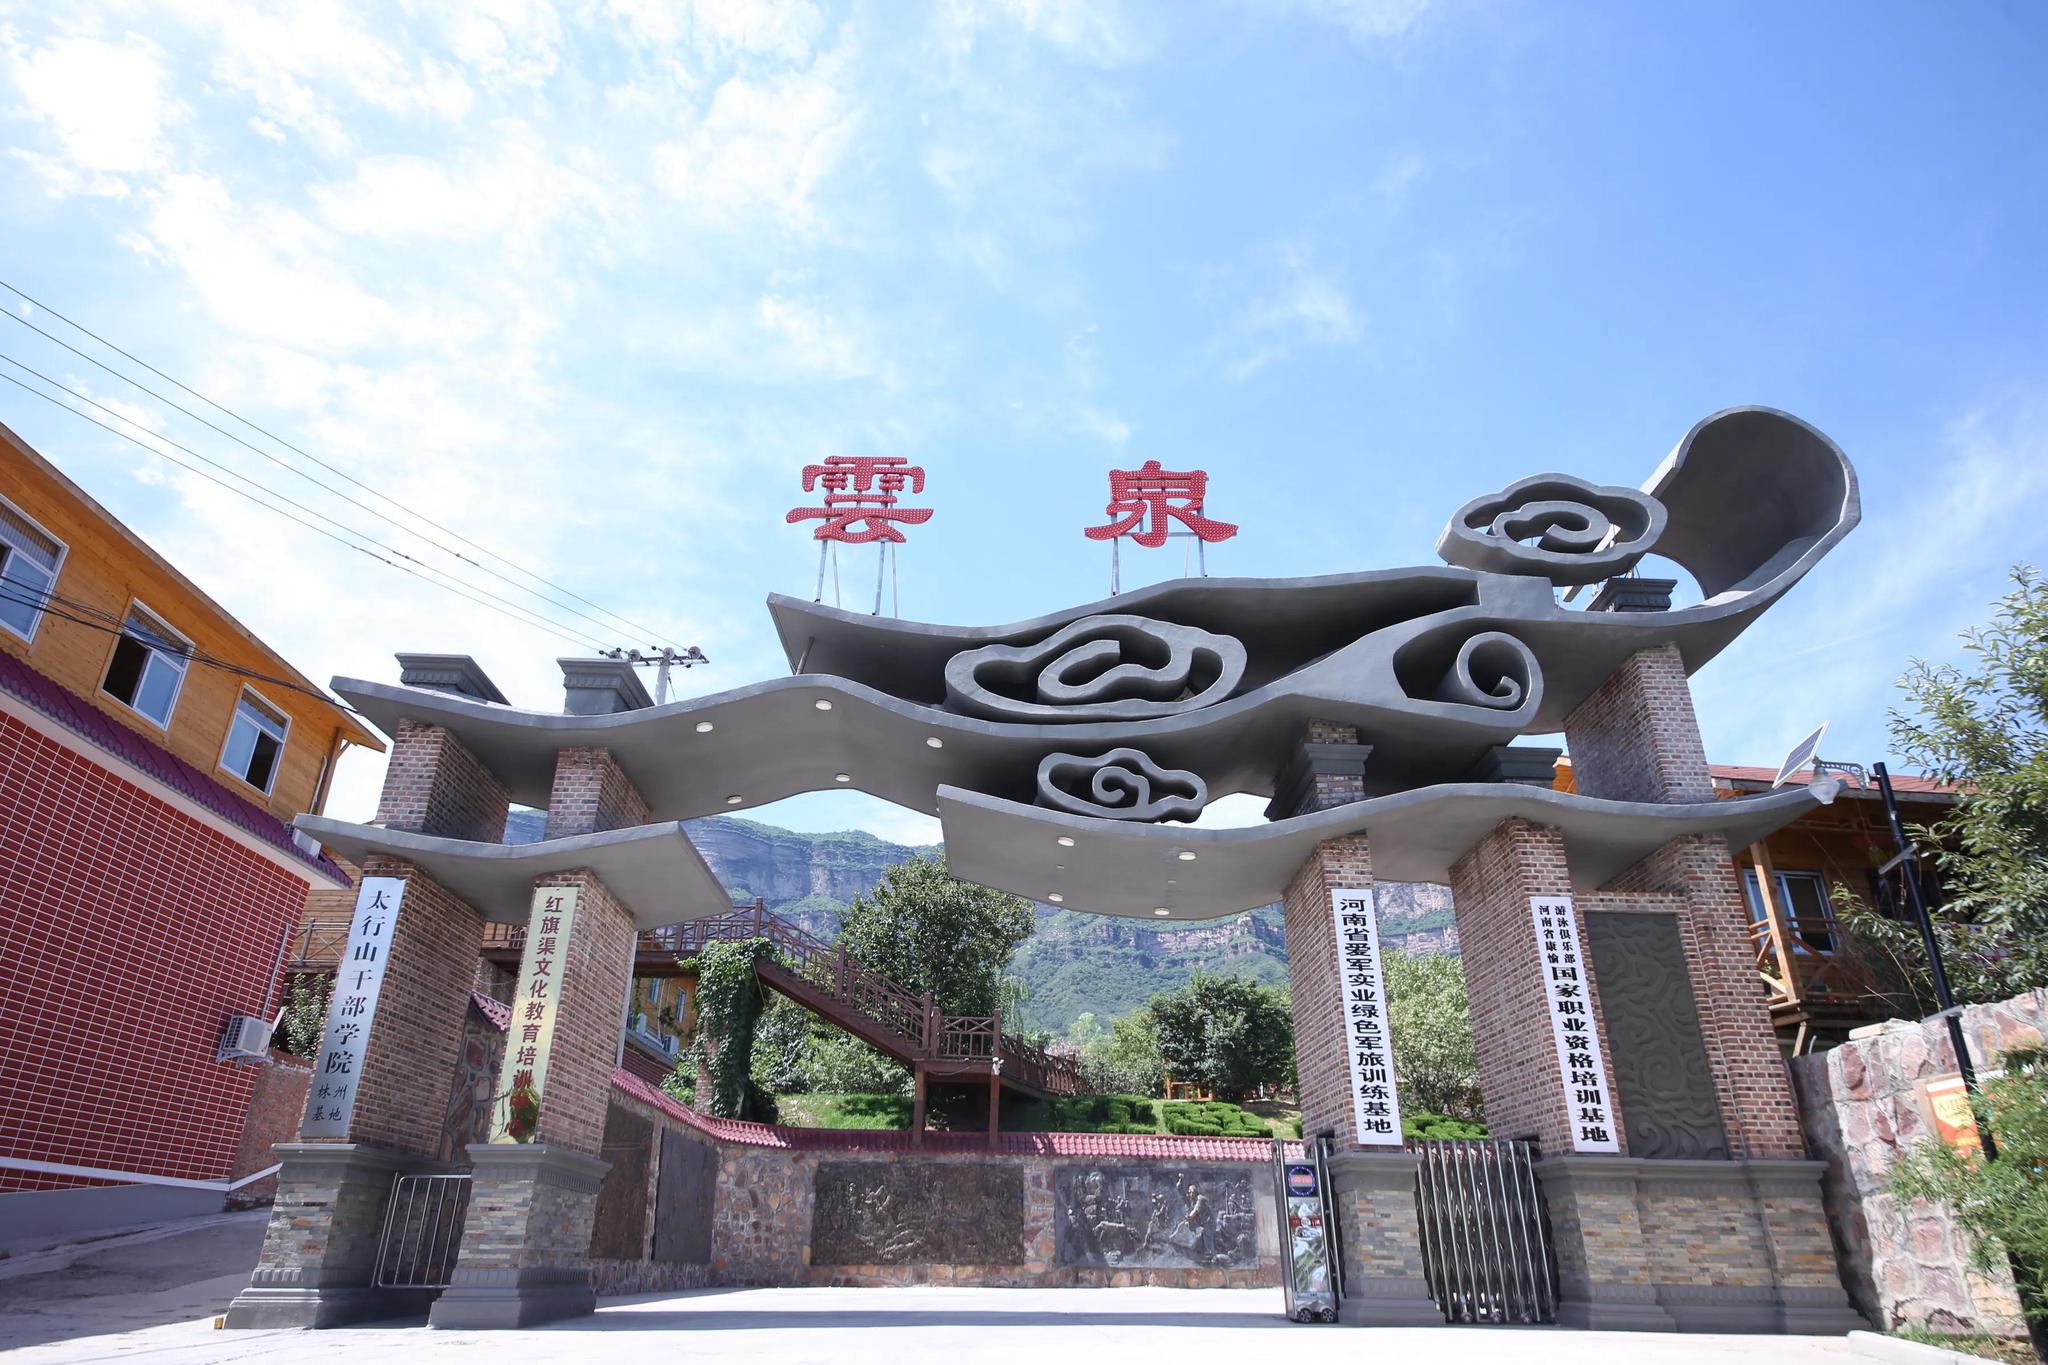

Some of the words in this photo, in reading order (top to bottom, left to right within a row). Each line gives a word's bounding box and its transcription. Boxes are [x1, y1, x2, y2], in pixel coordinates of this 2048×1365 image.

[786, 455, 1239, 548] 雲泉
[1539, 905, 1559, 964] 河南省康愉
[1555, 905, 1576, 964] 游泳俱乐部
[325, 890, 391, 1075] 太行山干部学院
[1341, 899, 1393, 1133] 河南省爱军实业绿色军旅训练基地
[317, 1083, 348, 1100] 林州
[1551, 966, 1610, 1142] 国家职业资格培训基地
[311, 1105, 342, 1121] 基地
